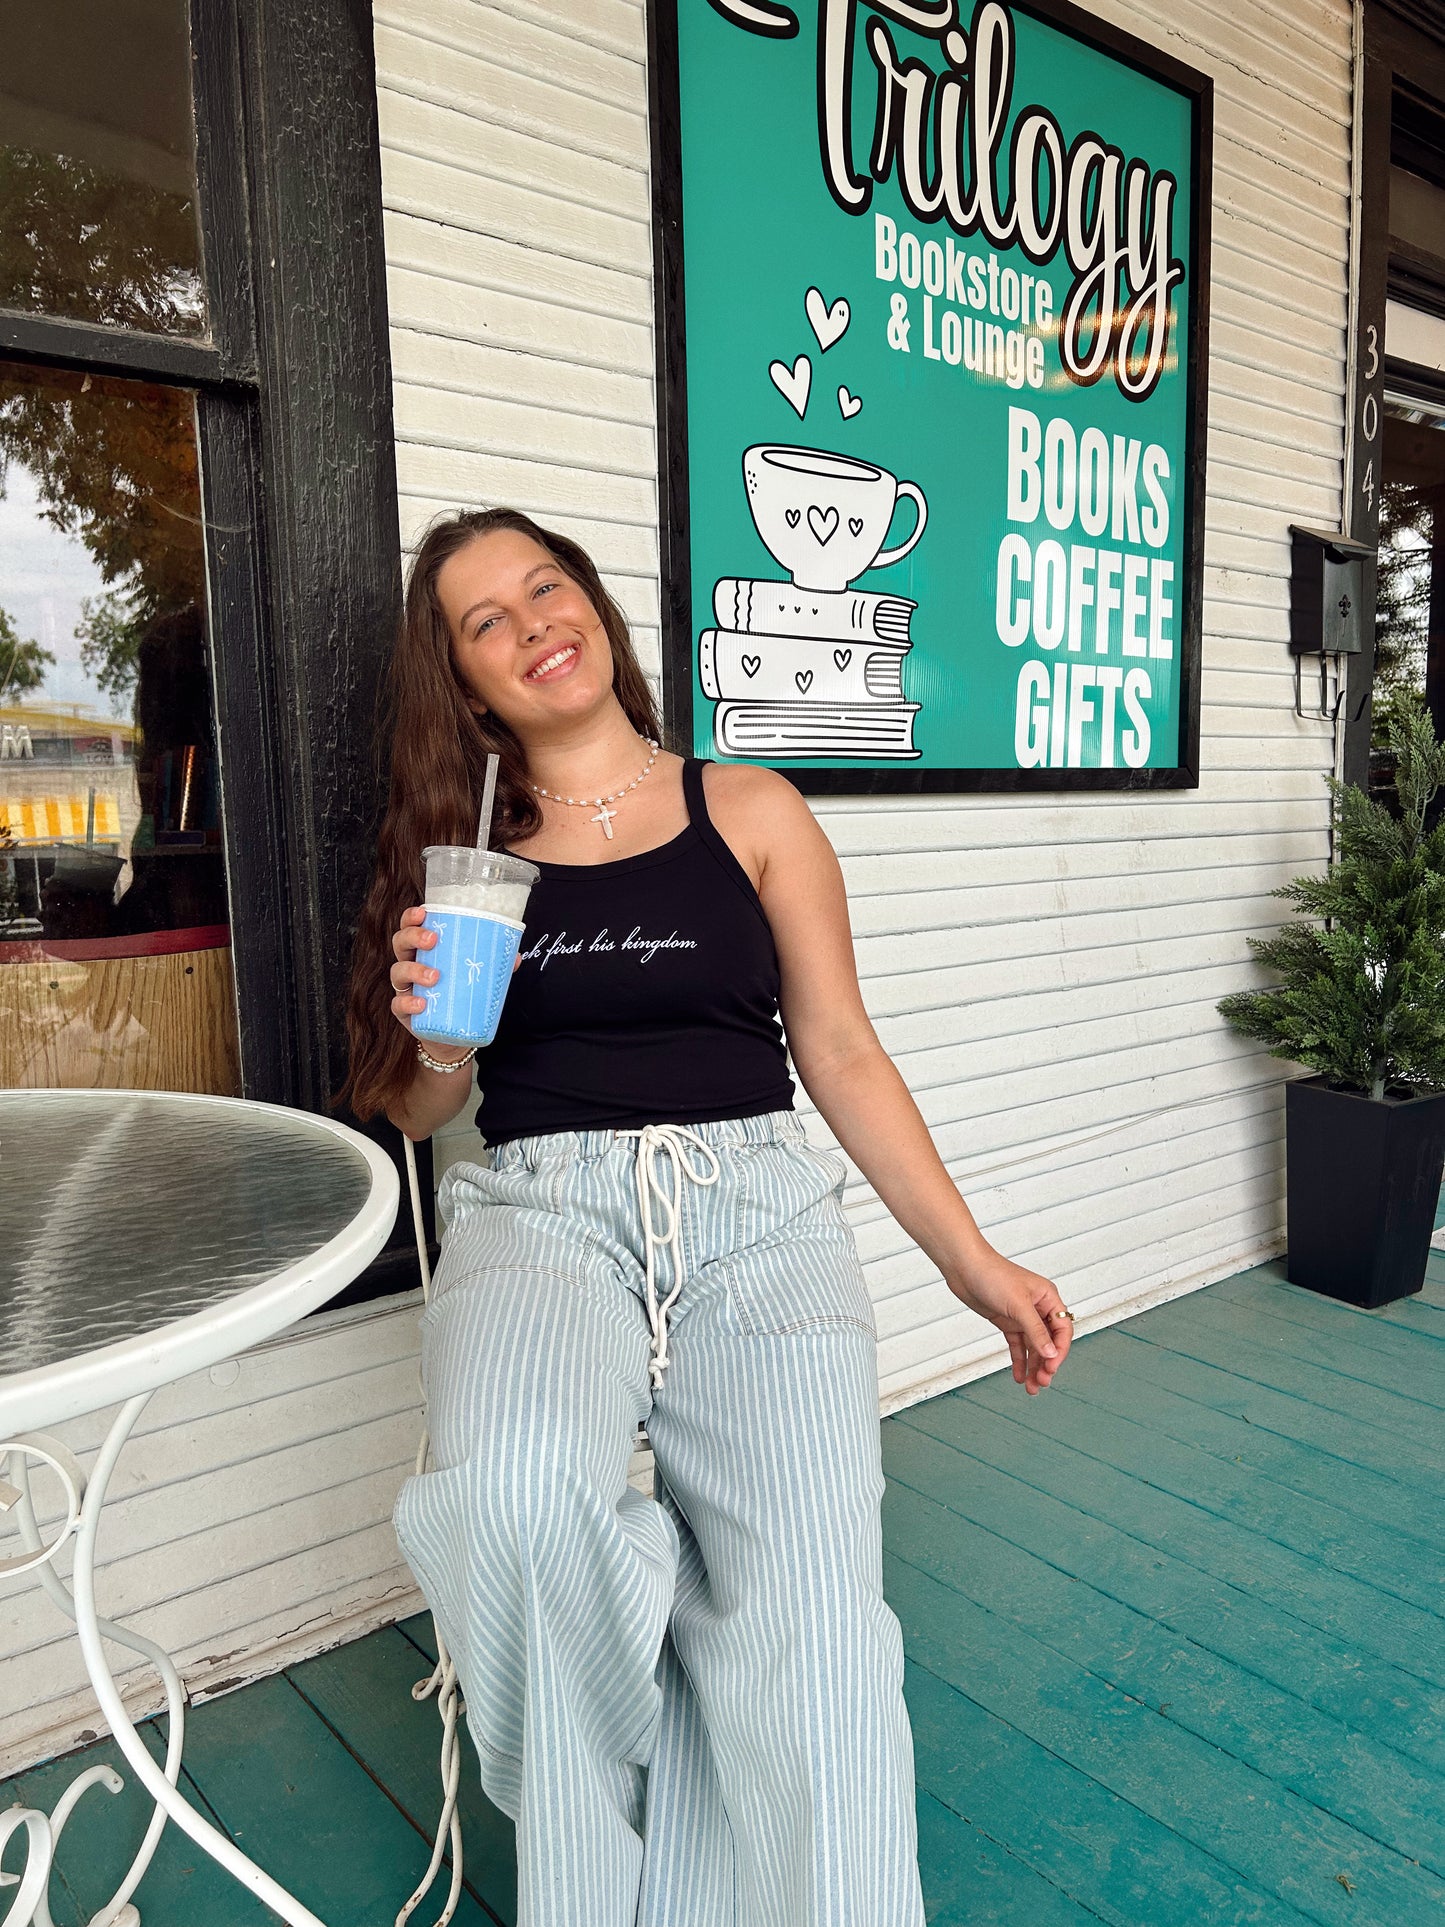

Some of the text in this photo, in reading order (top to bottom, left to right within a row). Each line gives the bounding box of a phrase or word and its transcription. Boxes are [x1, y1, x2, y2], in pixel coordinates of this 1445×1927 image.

[704, 0, 1184, 403] Trilogy
[874, 213, 1054, 330] Bookstore
[886, 292, 1045, 390] & Lounge
[1007, 406, 1169, 547] BOOKS
[1362, 324, 1379, 512] 304
[995, 533, 1174, 659] COFFEE
[1014, 660, 1152, 769] GIFTS
[521, 926, 698, 971] ek first his kingdom
